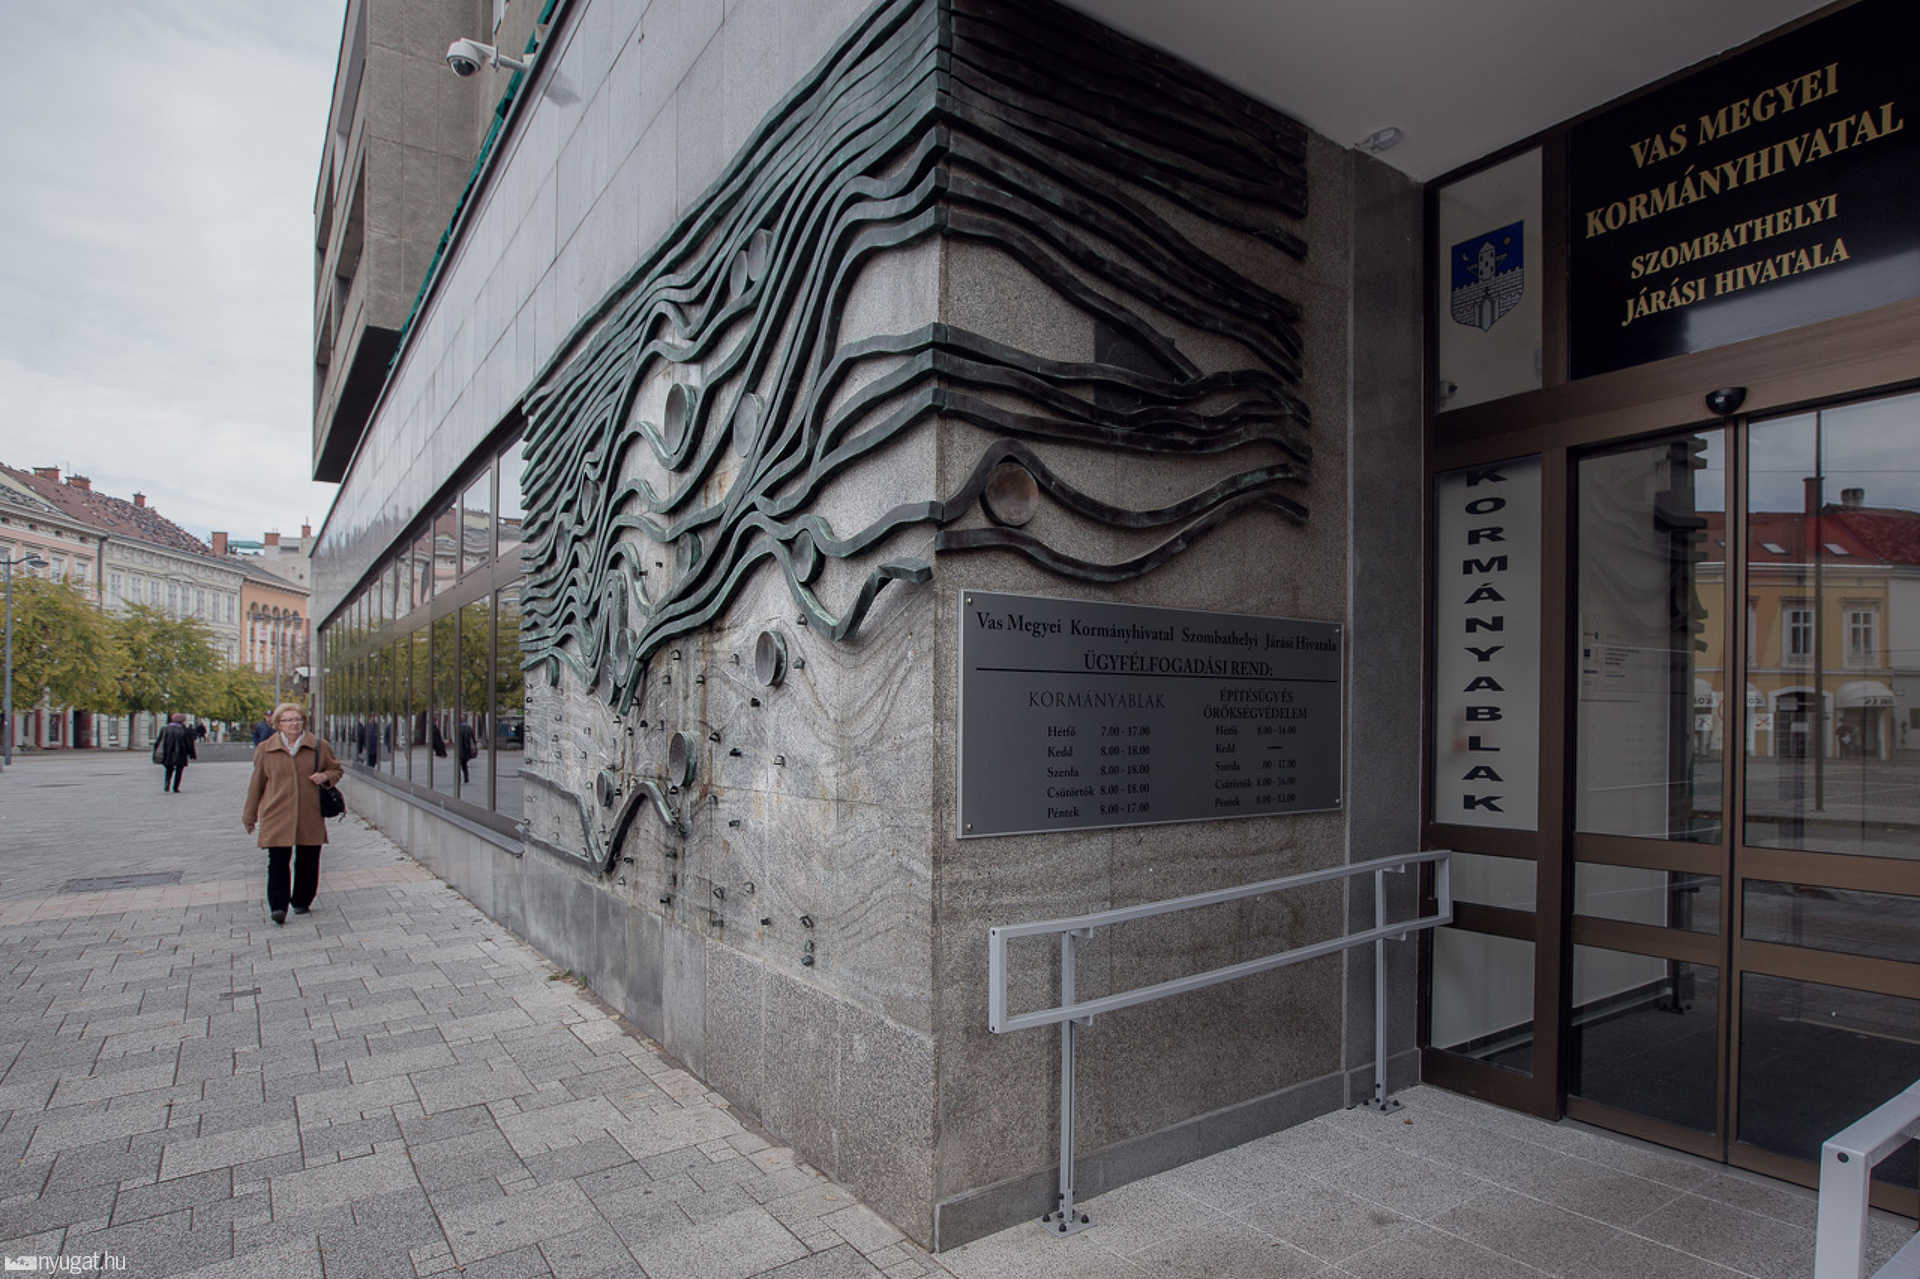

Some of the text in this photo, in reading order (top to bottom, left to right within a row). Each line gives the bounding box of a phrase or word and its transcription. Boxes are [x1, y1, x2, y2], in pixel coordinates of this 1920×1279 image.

[1630, 62, 1840, 169] VAS MEGYEI
[1585, 101, 1904, 239] KORMÁNYHIVATAL
[1630, 193, 1840, 279] SZOMBATHELYI
[1621, 237, 1850, 327] JÁRÁSI HIVATALA
[976, 611, 1003, 632] Vas
[1007, 613, 1062, 639] Megyei
[1071, 618, 1174, 644] Kormányhivatal
[1181, 626, 1259, 651] Szombathelyi
[1296, 634, 1337, 652] Hivatala
[1084, 650, 1227, 676] ÜGYFÉLFOGADÁSI
[1462, 469, 1508, 813] KORMÁNYABLAK
[1029, 689, 1166, 709] KORMÁNYABLAK
[1047, 745, 1073, 757] Kedd
[1047, 765, 1079, 777] Szerda
